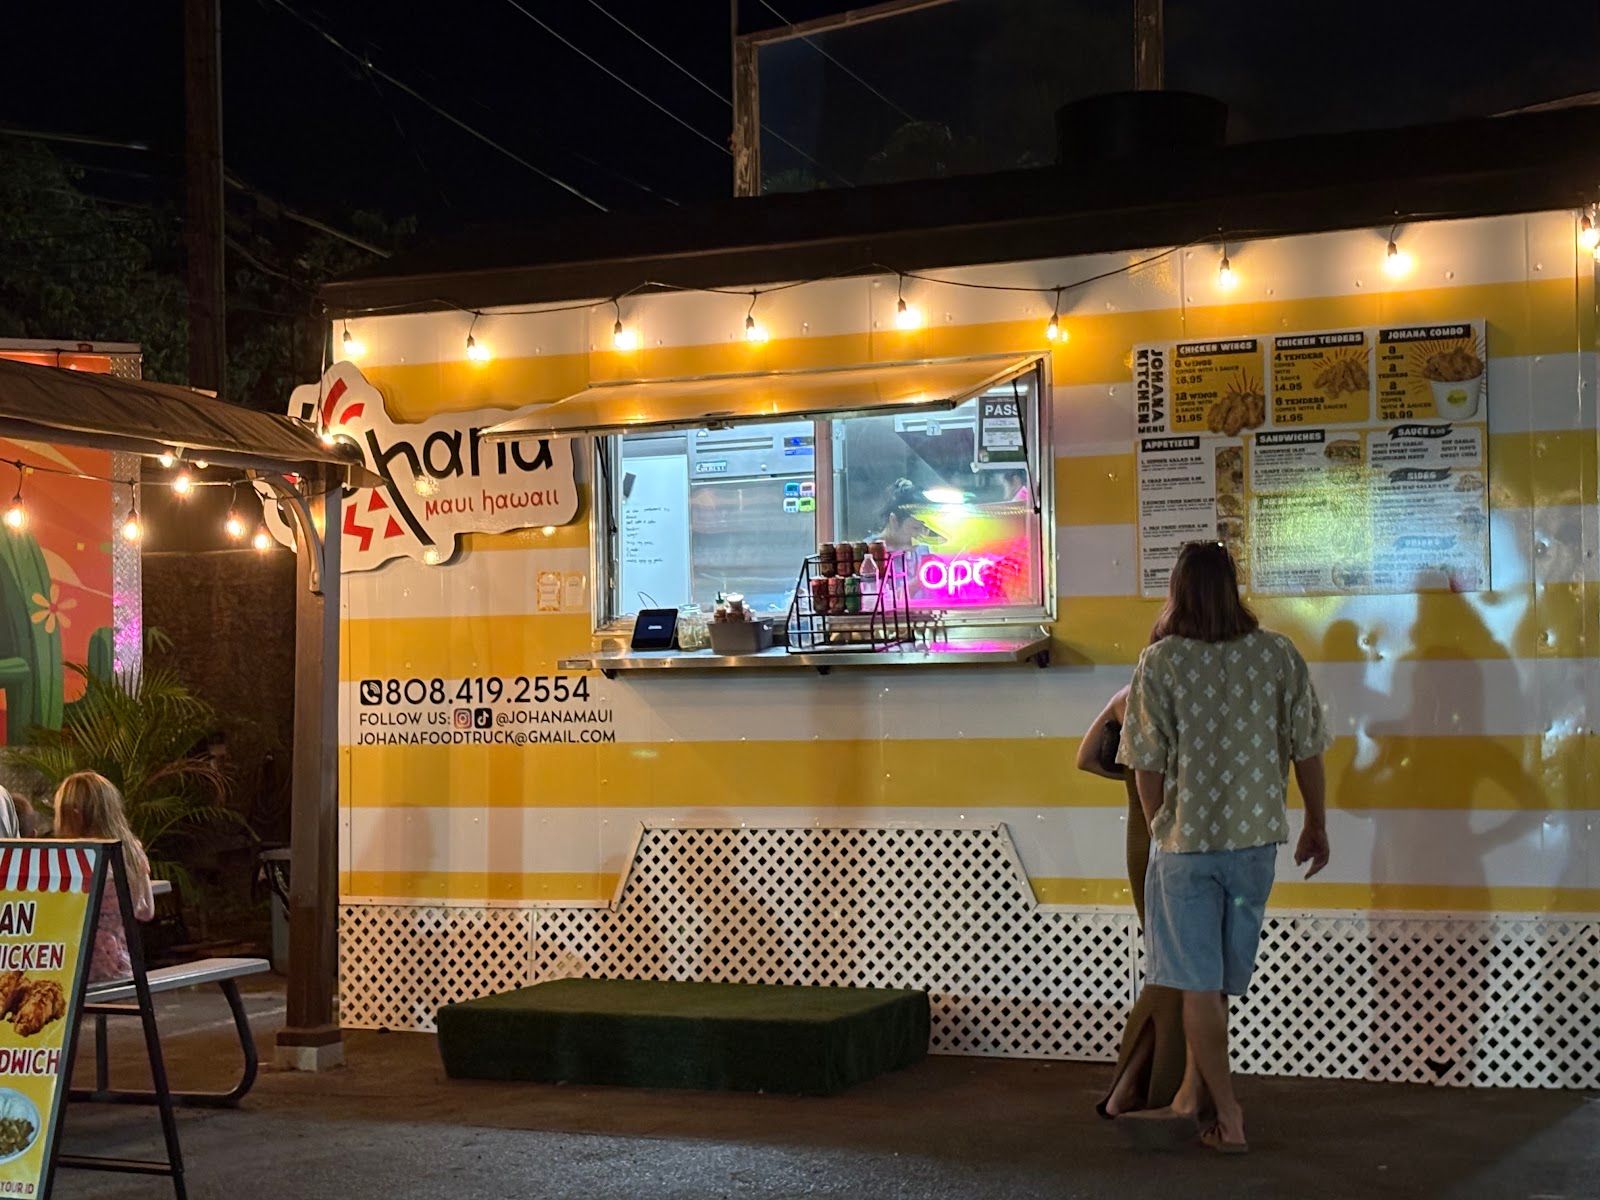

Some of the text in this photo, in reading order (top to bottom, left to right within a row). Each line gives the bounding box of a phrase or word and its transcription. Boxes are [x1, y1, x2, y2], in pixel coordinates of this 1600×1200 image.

[1387, 327, 1464, 340] JOHANA COMBO
[1276, 334, 1362, 347] CHICKEN TENDERS
[1179, 341, 1253, 355] CHICKEN WINGS
[1274, 352, 1324, 361] 4 TENDERS
[1137, 349, 1149, 424] KITCHEN
[1151, 349, 1164, 423] JOHANA
[1284, 396, 1325, 405] TENDERS
[1259, 432, 1322, 443] SANDWICHES
[1397, 428, 1429, 436] SAUCE
[1144, 439, 1195, 449] APPETIZER
[385, 676, 590, 705] 808.419.2554
[359, 709, 612, 727] FOLLOW US: @JOHANAMAUI
[357, 729, 616, 746] JOHANAFOODTRUCK@GMAIL.COM
[0, 944, 64, 969] ICKEN
